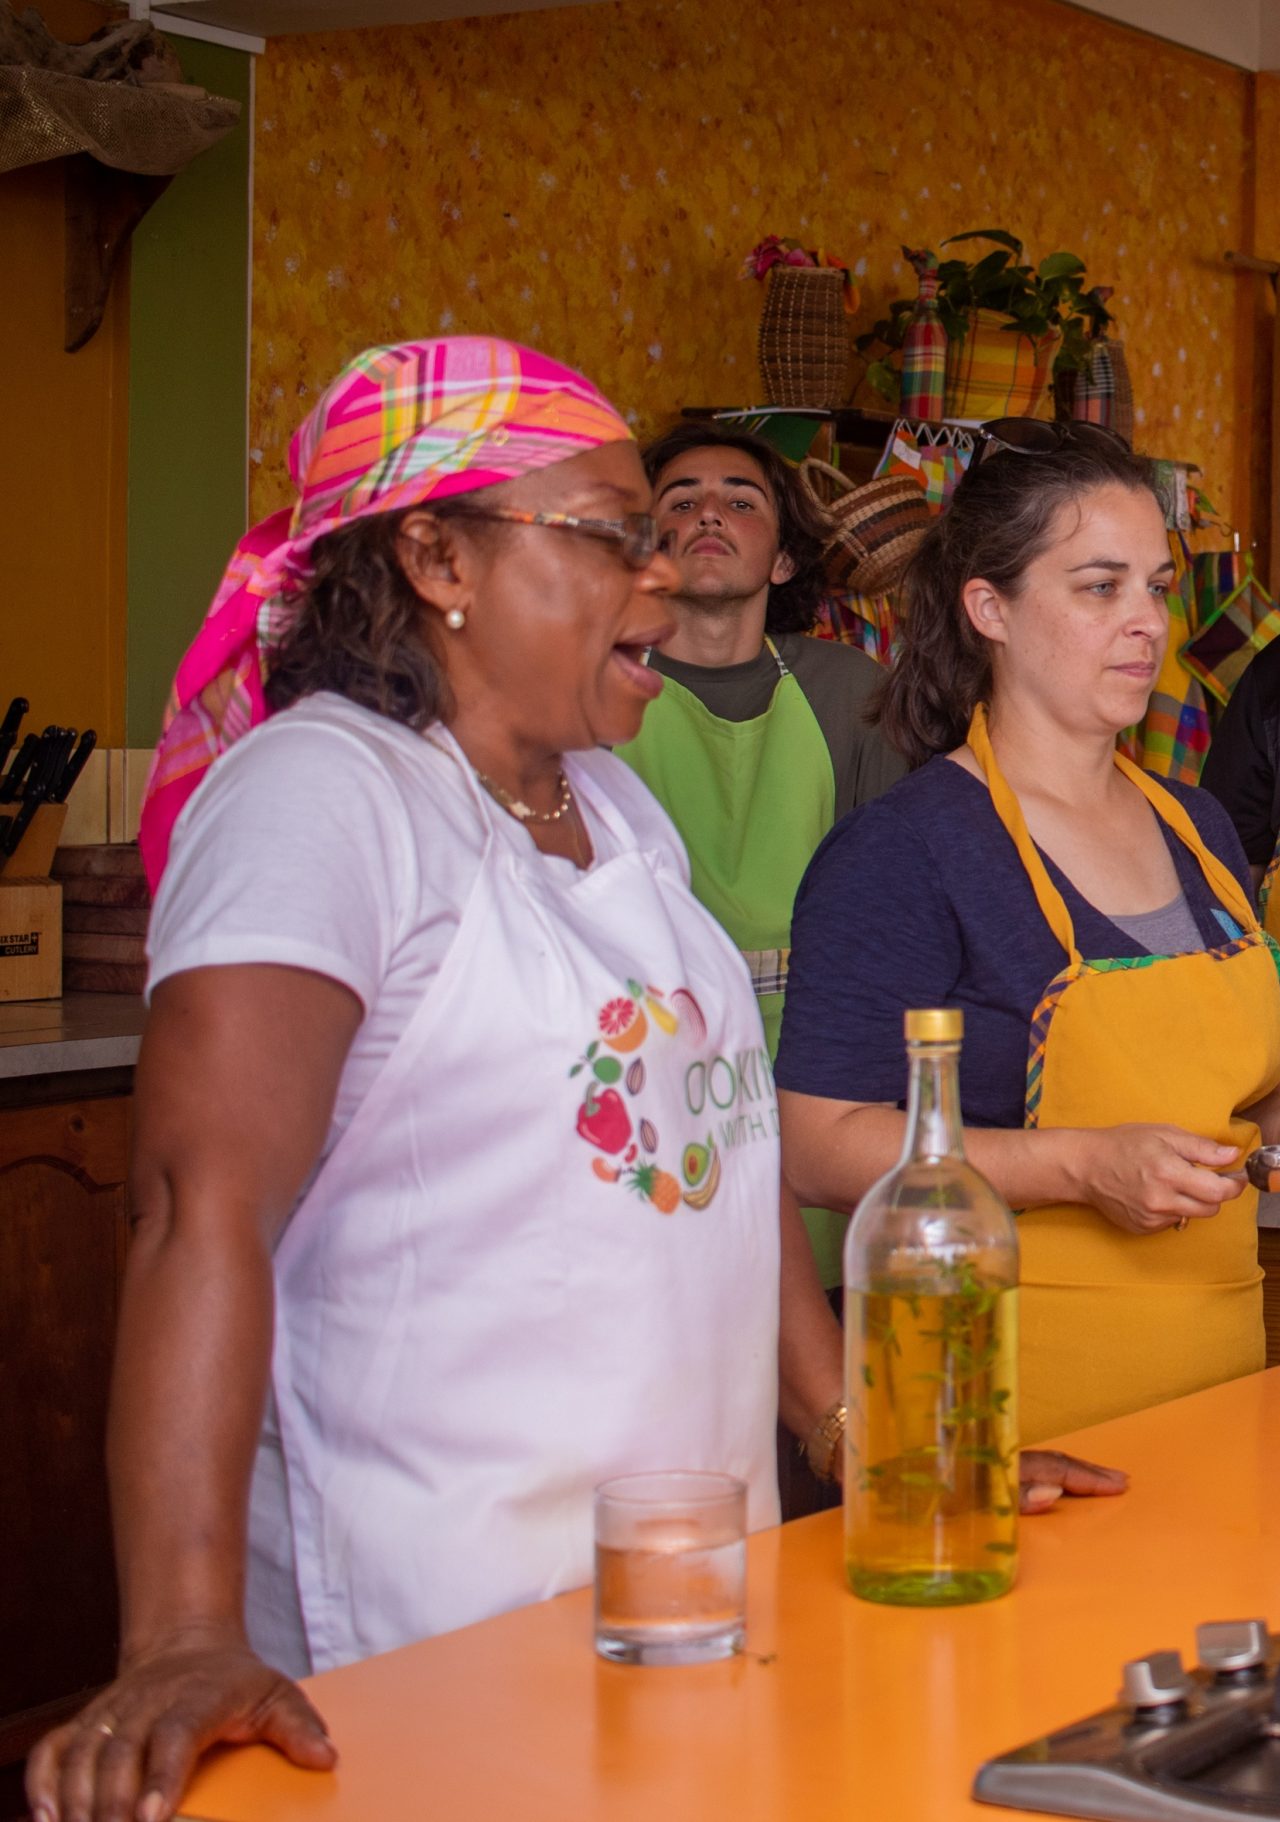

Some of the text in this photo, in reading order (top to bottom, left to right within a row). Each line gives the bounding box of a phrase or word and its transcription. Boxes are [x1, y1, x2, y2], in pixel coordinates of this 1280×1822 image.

[9, 934, 29, 943] STAR
[5, 945, 37, 955] CUTLERY
[719, 1113, 768, 1149] WITH
